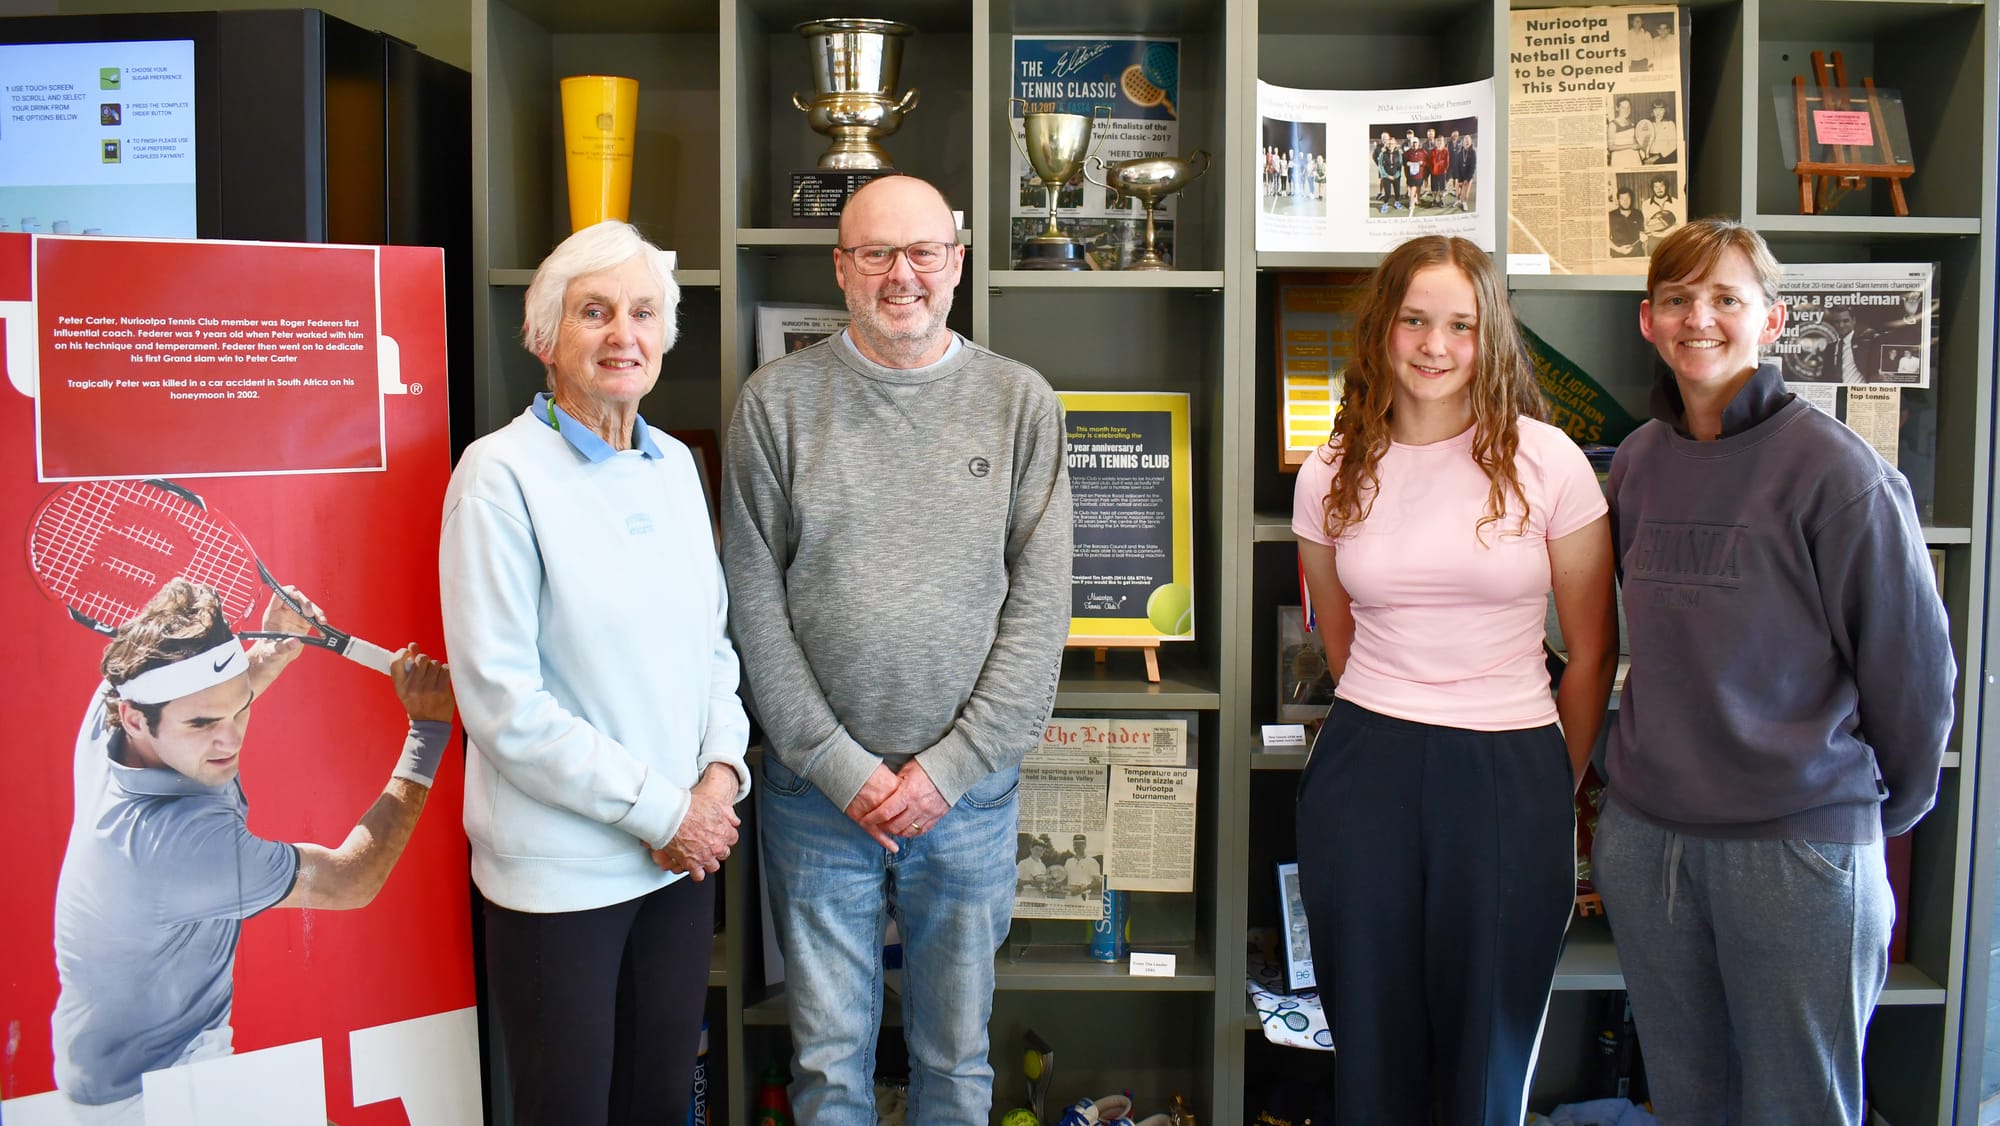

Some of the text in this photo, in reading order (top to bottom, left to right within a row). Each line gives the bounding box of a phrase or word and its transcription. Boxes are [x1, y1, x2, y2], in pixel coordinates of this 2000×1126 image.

[1526, 16, 1608, 32] Nuriootpa
[1525, 30, 1610, 47] Tennis and
[1510, 47, 1627, 64] Netball Courts
[1021, 61, 1044, 77] THE
[1514, 67, 1531, 79] to
[1536, 65, 1556, 78] be
[1561, 61, 1624, 79] Opened
[1021, 82, 1117, 99] TENNIS CLASSIC
[1522, 79, 1616, 95] This Sunday
[62, 93, 86, 101] SELECT
[55, 113, 78, 121] BELOW
[1112, 122, 1168, 131] finalists of the
[1093, 132, 1172, 142] Tennis Classic 2017
[1132, 150, 1144, 158] TO
[1889, 282, 1920, 290] champion
[1811, 292, 1900, 309] a gentleman
[58, 316, 84, 325] Peter
[85, 316, 118, 326] Carter,
[120, 316, 166, 327] Nuriootpa
[167, 317, 196, 326] Tennis
[198, 317, 219, 326] Club
[221, 319, 259, 327] member
[280, 319, 306, 328] Roger
[307, 319, 343, 327] Federers
[344, 319, 360, 327] first
[1792, 311, 1824, 324] very
[53, 328, 100, 337] influential
[101, 329, 136, 338] coach.
[137, 329, 174, 338] Federer
[195, 330, 201, 338] 9
[203, 331, 227, 339] years
[229, 330, 244, 339] old
[245, 330, 270, 339] when
[271, 330, 294, 339] Peter
[295, 331, 328, 339] worked
[329, 331, 347, 339] with
[348, 331, 364, 339] him
[54, 341, 364, 351] on his technique and temperament. Federer then went on to dedicate
[1775, 341, 1802, 354] him
[130, 354, 298, 363] his first Grand slam win to Peter Carter
[67, 379, 114, 390] Tragically
[115, 379, 140, 388] Peter
[162, 379, 187, 387] killed
[189, 379, 198, 387] in
[225, 378, 266, 387] accident
[267, 378, 275, 387] in
[276, 378, 301, 387] South
[303, 378, 329, 386] Africa
[343, 378, 355, 386] his
[1559, 371, 1599, 402] LIGHT
[170, 390, 260, 400] honeymoon in 2002.
[1850, 393, 1890, 401] top tennis
[1093, 432, 1131, 440] celebrating
[1073, 443, 1143, 453] year anniversary of
[1067, 454, 1170, 468] OTPA TENNIS CLUB
[1043, 725, 1078, 746] The
[1080, 725, 1151, 745] Leader
[1041, 768, 1068, 777] sporting
[1068, 768, 1086, 776] event
[1087, 768, 1095, 776] to
[1124, 767, 1171, 777] Temperature
[1048, 774, 1075, 782] Barossa
[1075, 775, 1094, 783] Valley
[1126, 776, 1151, 784] tennis
[1152, 777, 1174, 785] sizzle
[1135, 784, 1174, 793] Nuriootpa
[1132, 792, 1177, 801] tournament
